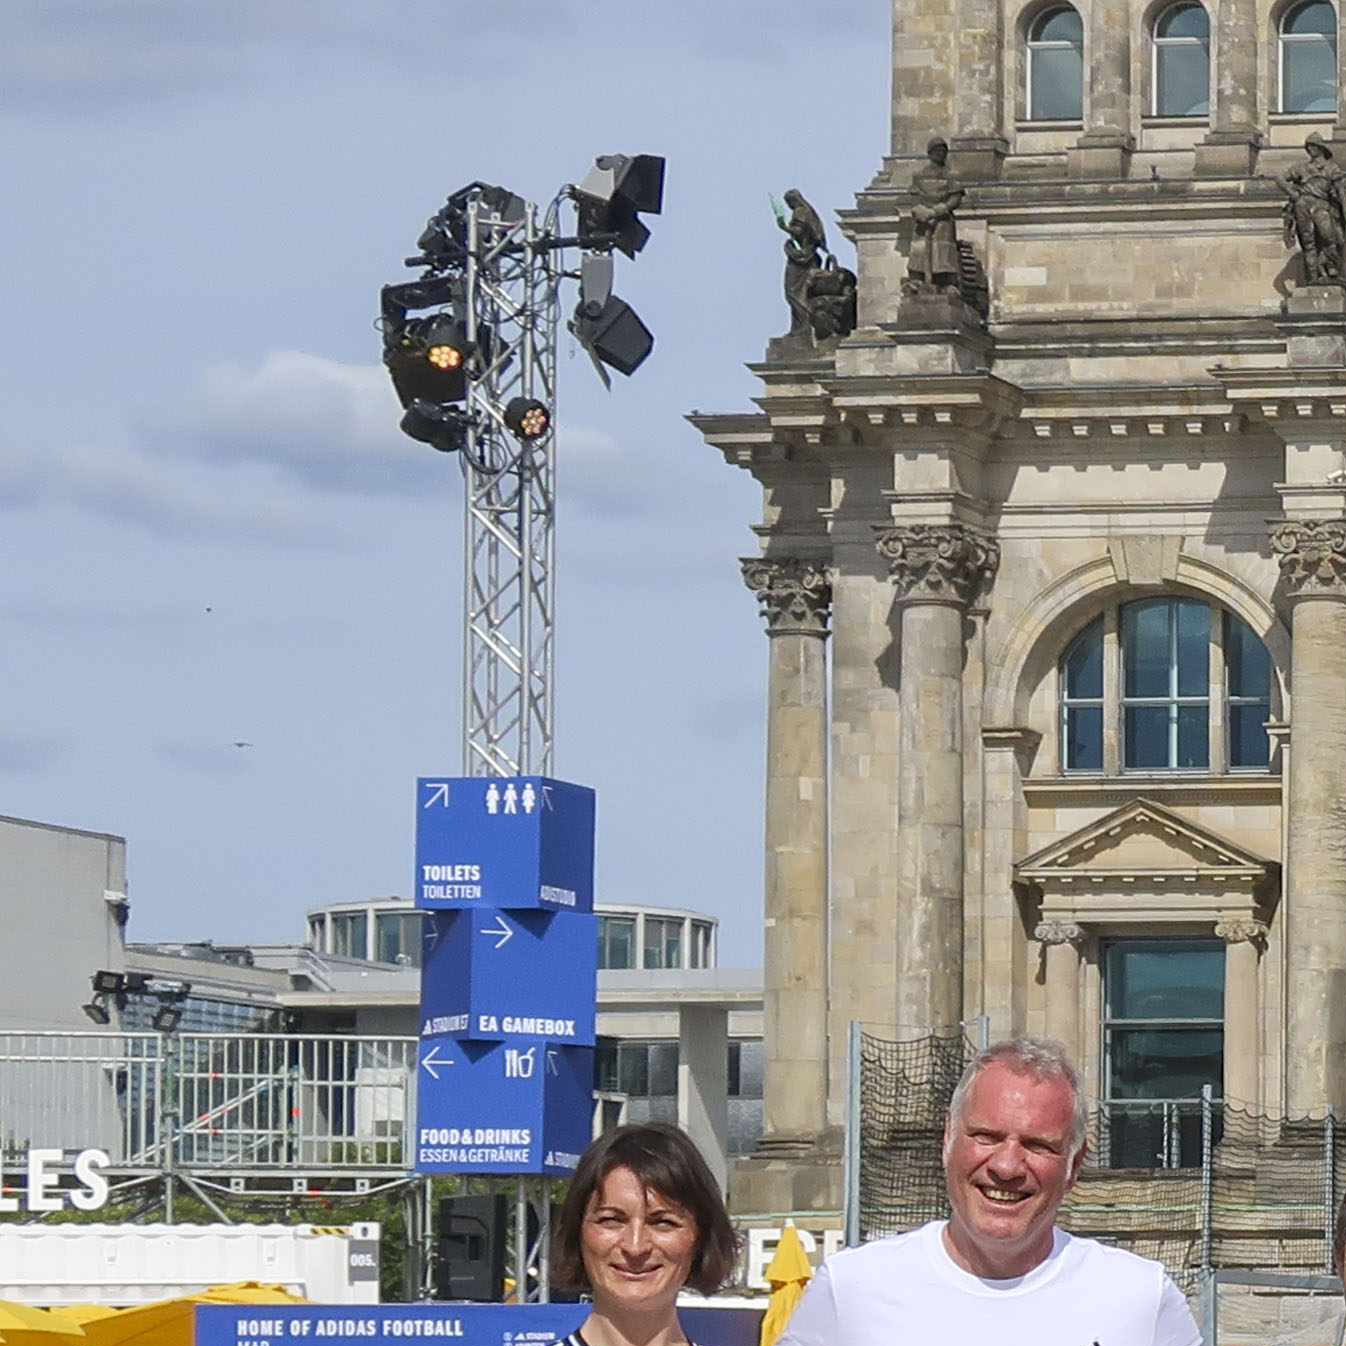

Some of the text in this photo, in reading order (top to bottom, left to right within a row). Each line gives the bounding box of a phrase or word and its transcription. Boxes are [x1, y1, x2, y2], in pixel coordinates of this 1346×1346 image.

[422, 865, 481, 881] TOILETS
[422, 884, 482, 899] TOILETTEN
[478, 1015, 498, 1032] EA
[502, 1016, 575, 1036] GAMEBOX
[237, 1320, 464, 1336] HOME OF ADIDAS FOOTBALL
